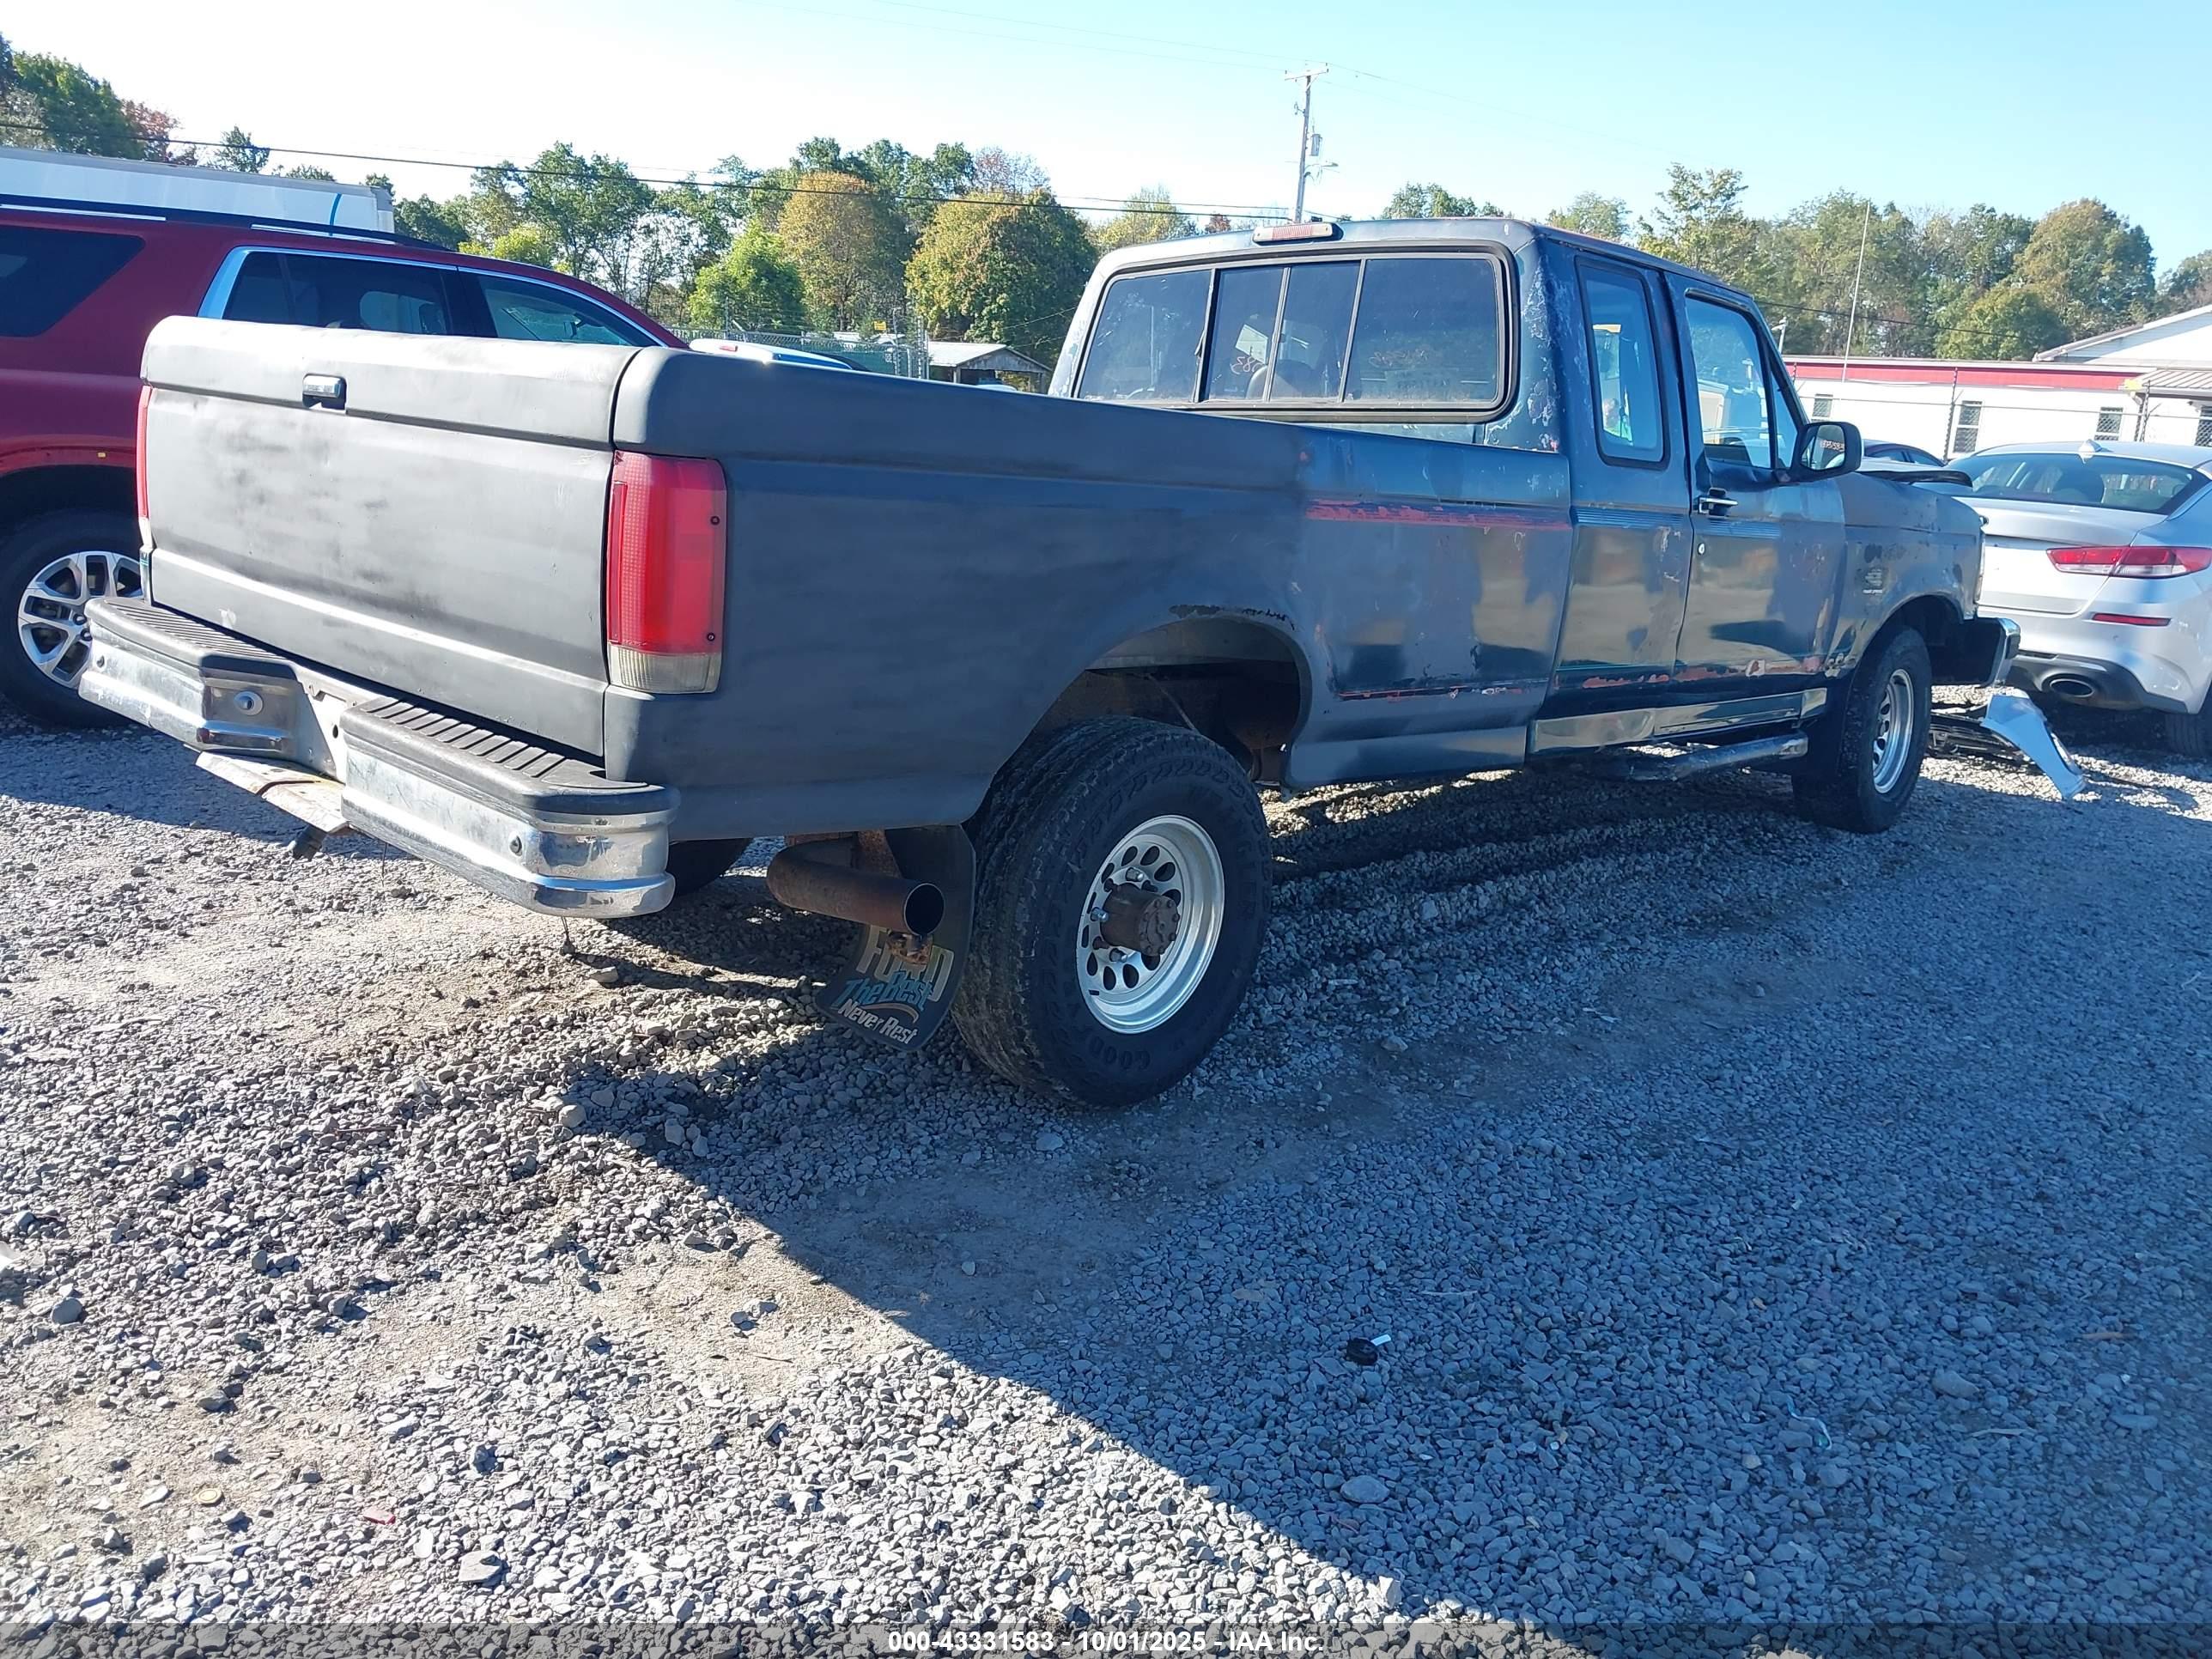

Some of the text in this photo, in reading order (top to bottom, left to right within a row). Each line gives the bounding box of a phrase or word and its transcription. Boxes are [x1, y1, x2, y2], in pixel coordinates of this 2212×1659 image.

[830, 977, 884, 1011] The
[837, 998, 919, 1045] Never Rest
